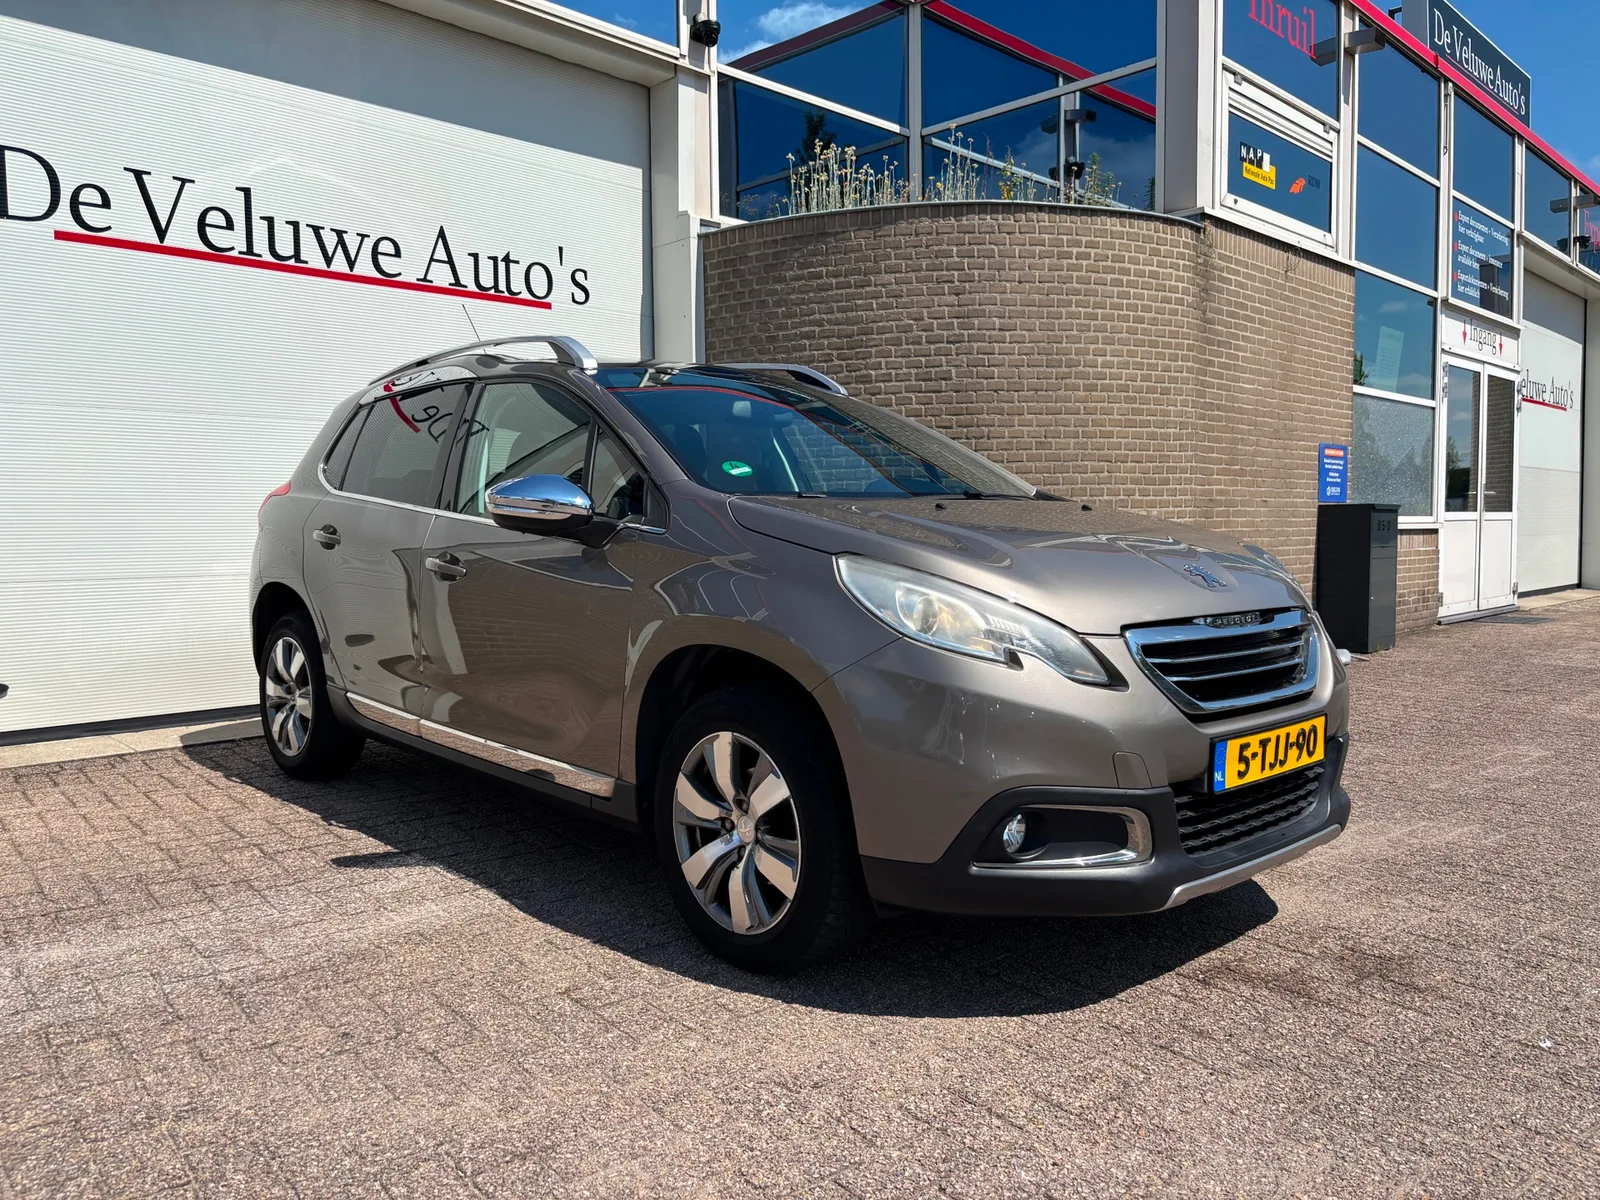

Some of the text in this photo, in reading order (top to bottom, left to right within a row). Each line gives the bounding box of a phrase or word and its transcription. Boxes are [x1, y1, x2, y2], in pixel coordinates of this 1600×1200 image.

[1434, 8, 1526, 115] De Veluwe Auto's
[1241, 145, 1262, 160] NAP
[0, 144, 590, 306] De Veluwe Auto's
[1469, 319, 1497, 355] Ingang
[1520, 368, 1574, 409] eluwe Auto's
[1214, 613, 1257, 627] PEUGEOT
[1236, 724, 1318, 780] 5-TJJ-90
[1214, 770, 1225, 782] NL
